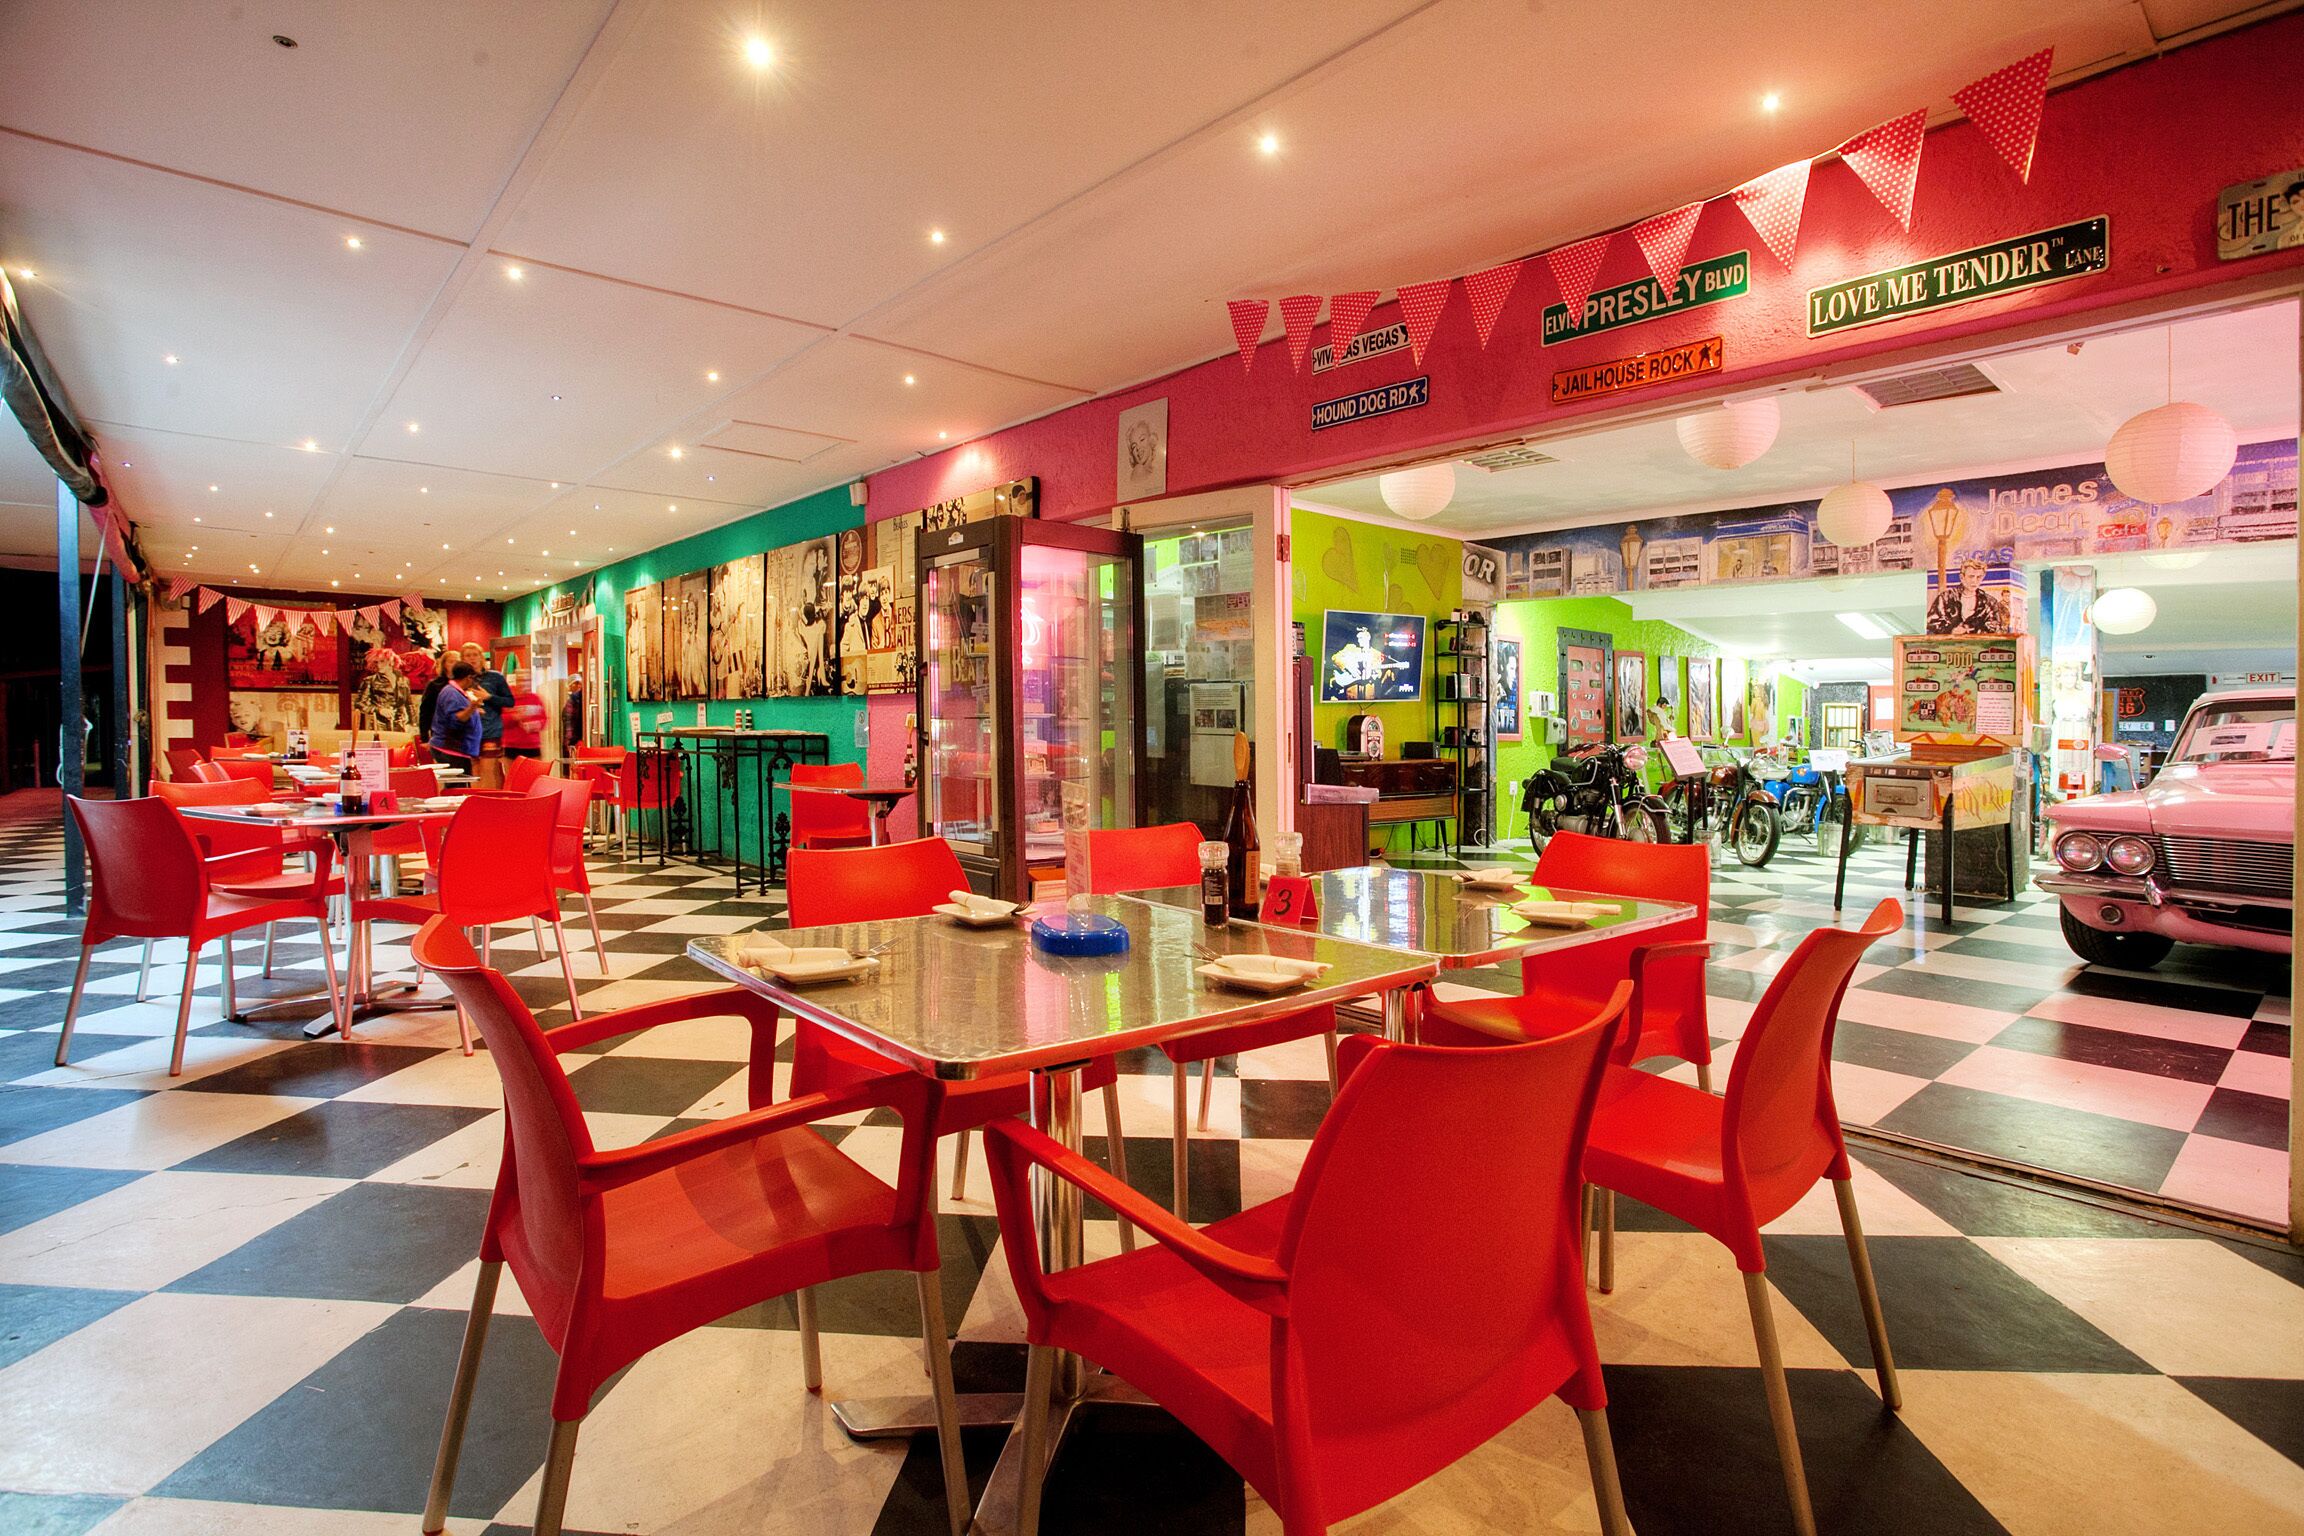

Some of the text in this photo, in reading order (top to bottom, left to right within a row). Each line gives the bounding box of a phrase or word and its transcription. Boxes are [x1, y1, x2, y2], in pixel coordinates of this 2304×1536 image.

[2227, 194, 2280, 240] THE
[1705, 263, 1745, 293] BLVD
[1813, 281, 1880, 327] LOVE
[1886, 270, 1928, 309] ME
[1934, 240, 2051, 298] TENDER
[2064, 245, 2102, 269] LANE
[1316, 328, 1399, 367] VIV AS VEGAS
[1562, 350, 1695, 396] JAILHOUSE ROCK
[1316, 386, 1408, 425] HOUND DOG RD
[1980, 480, 2098, 516] James
[1946, 652, 1973, 669] POLO
[2249, 673, 2277, 682] EXIT
[380, 797, 390, 811] 4
[1274, 889, 1293, 916] 3
